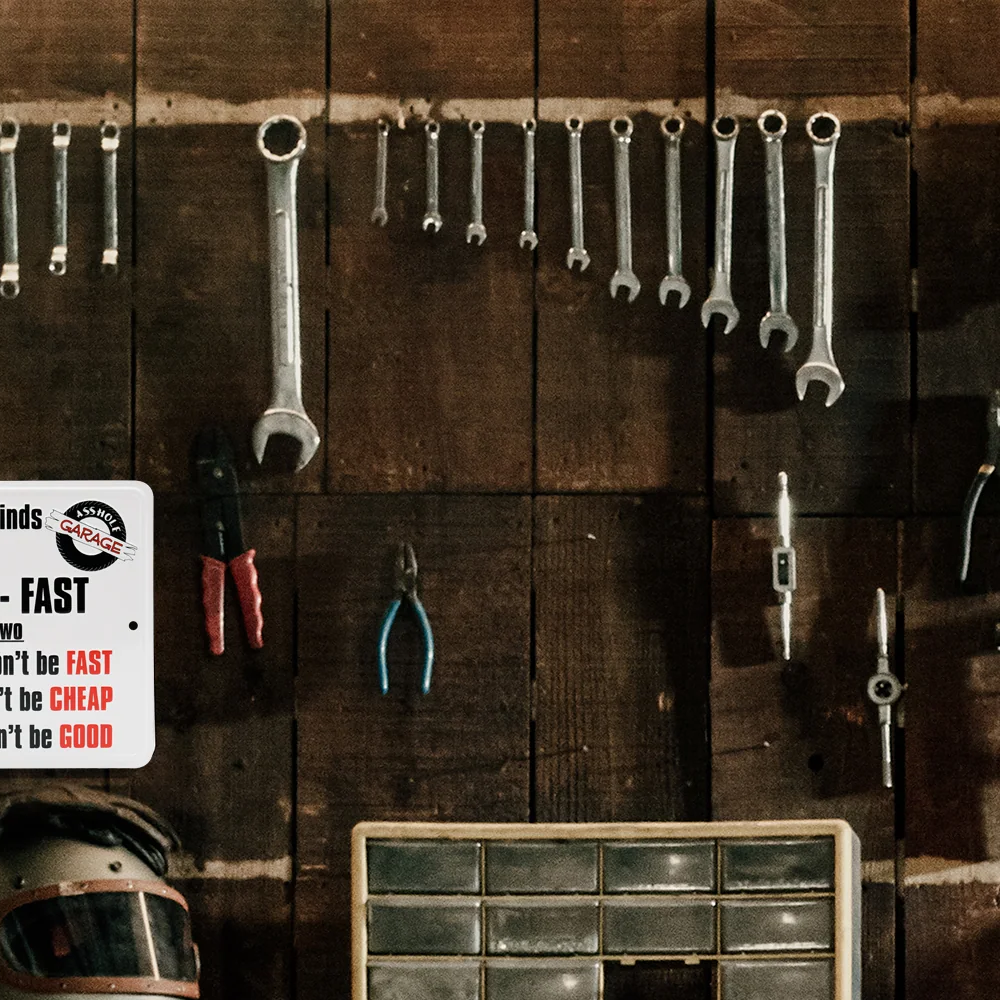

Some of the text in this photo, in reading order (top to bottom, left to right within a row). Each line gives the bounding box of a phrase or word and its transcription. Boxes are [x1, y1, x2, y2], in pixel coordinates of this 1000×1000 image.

[77, 506, 121, 532] ASSHOLE
[60, 519, 123, 554] GARAGE
[22, 577, 89, 614] FAST
[37, 651, 59, 675] be
[67, 650, 112, 675] FAST
[20, 687, 42, 711] be
[50, 686, 113, 711] CHEAP
[30, 725, 52, 748] be
[60, 724, 112, 748] GOOD
